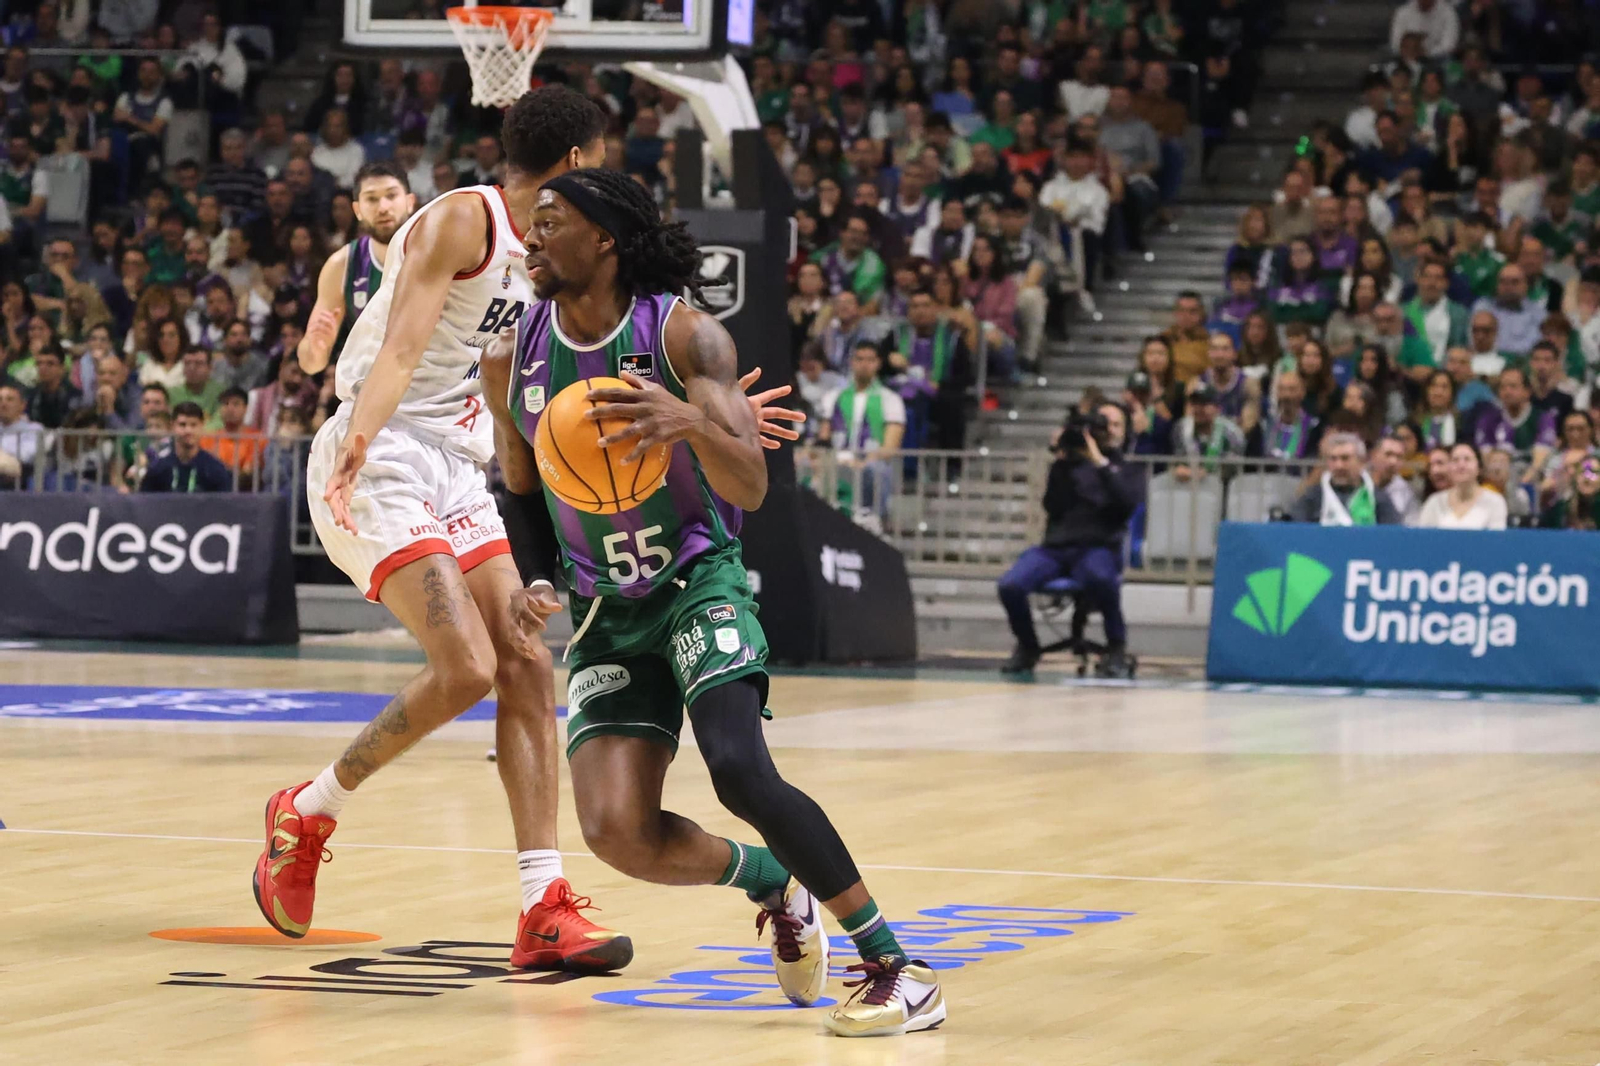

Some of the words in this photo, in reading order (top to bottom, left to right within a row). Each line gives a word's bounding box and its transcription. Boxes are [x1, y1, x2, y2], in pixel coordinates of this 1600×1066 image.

[476, 297, 532, 334] BA
[622, 361, 636, 370] liga
[627, 367, 652, 375] ndesa
[447, 515, 479, 536] ETL
[602, 524, 673, 585] 55
[1345, 559, 1589, 607] Fundación
[712, 610, 731, 620] acb
[1342, 602, 1518, 658] Unicaja
